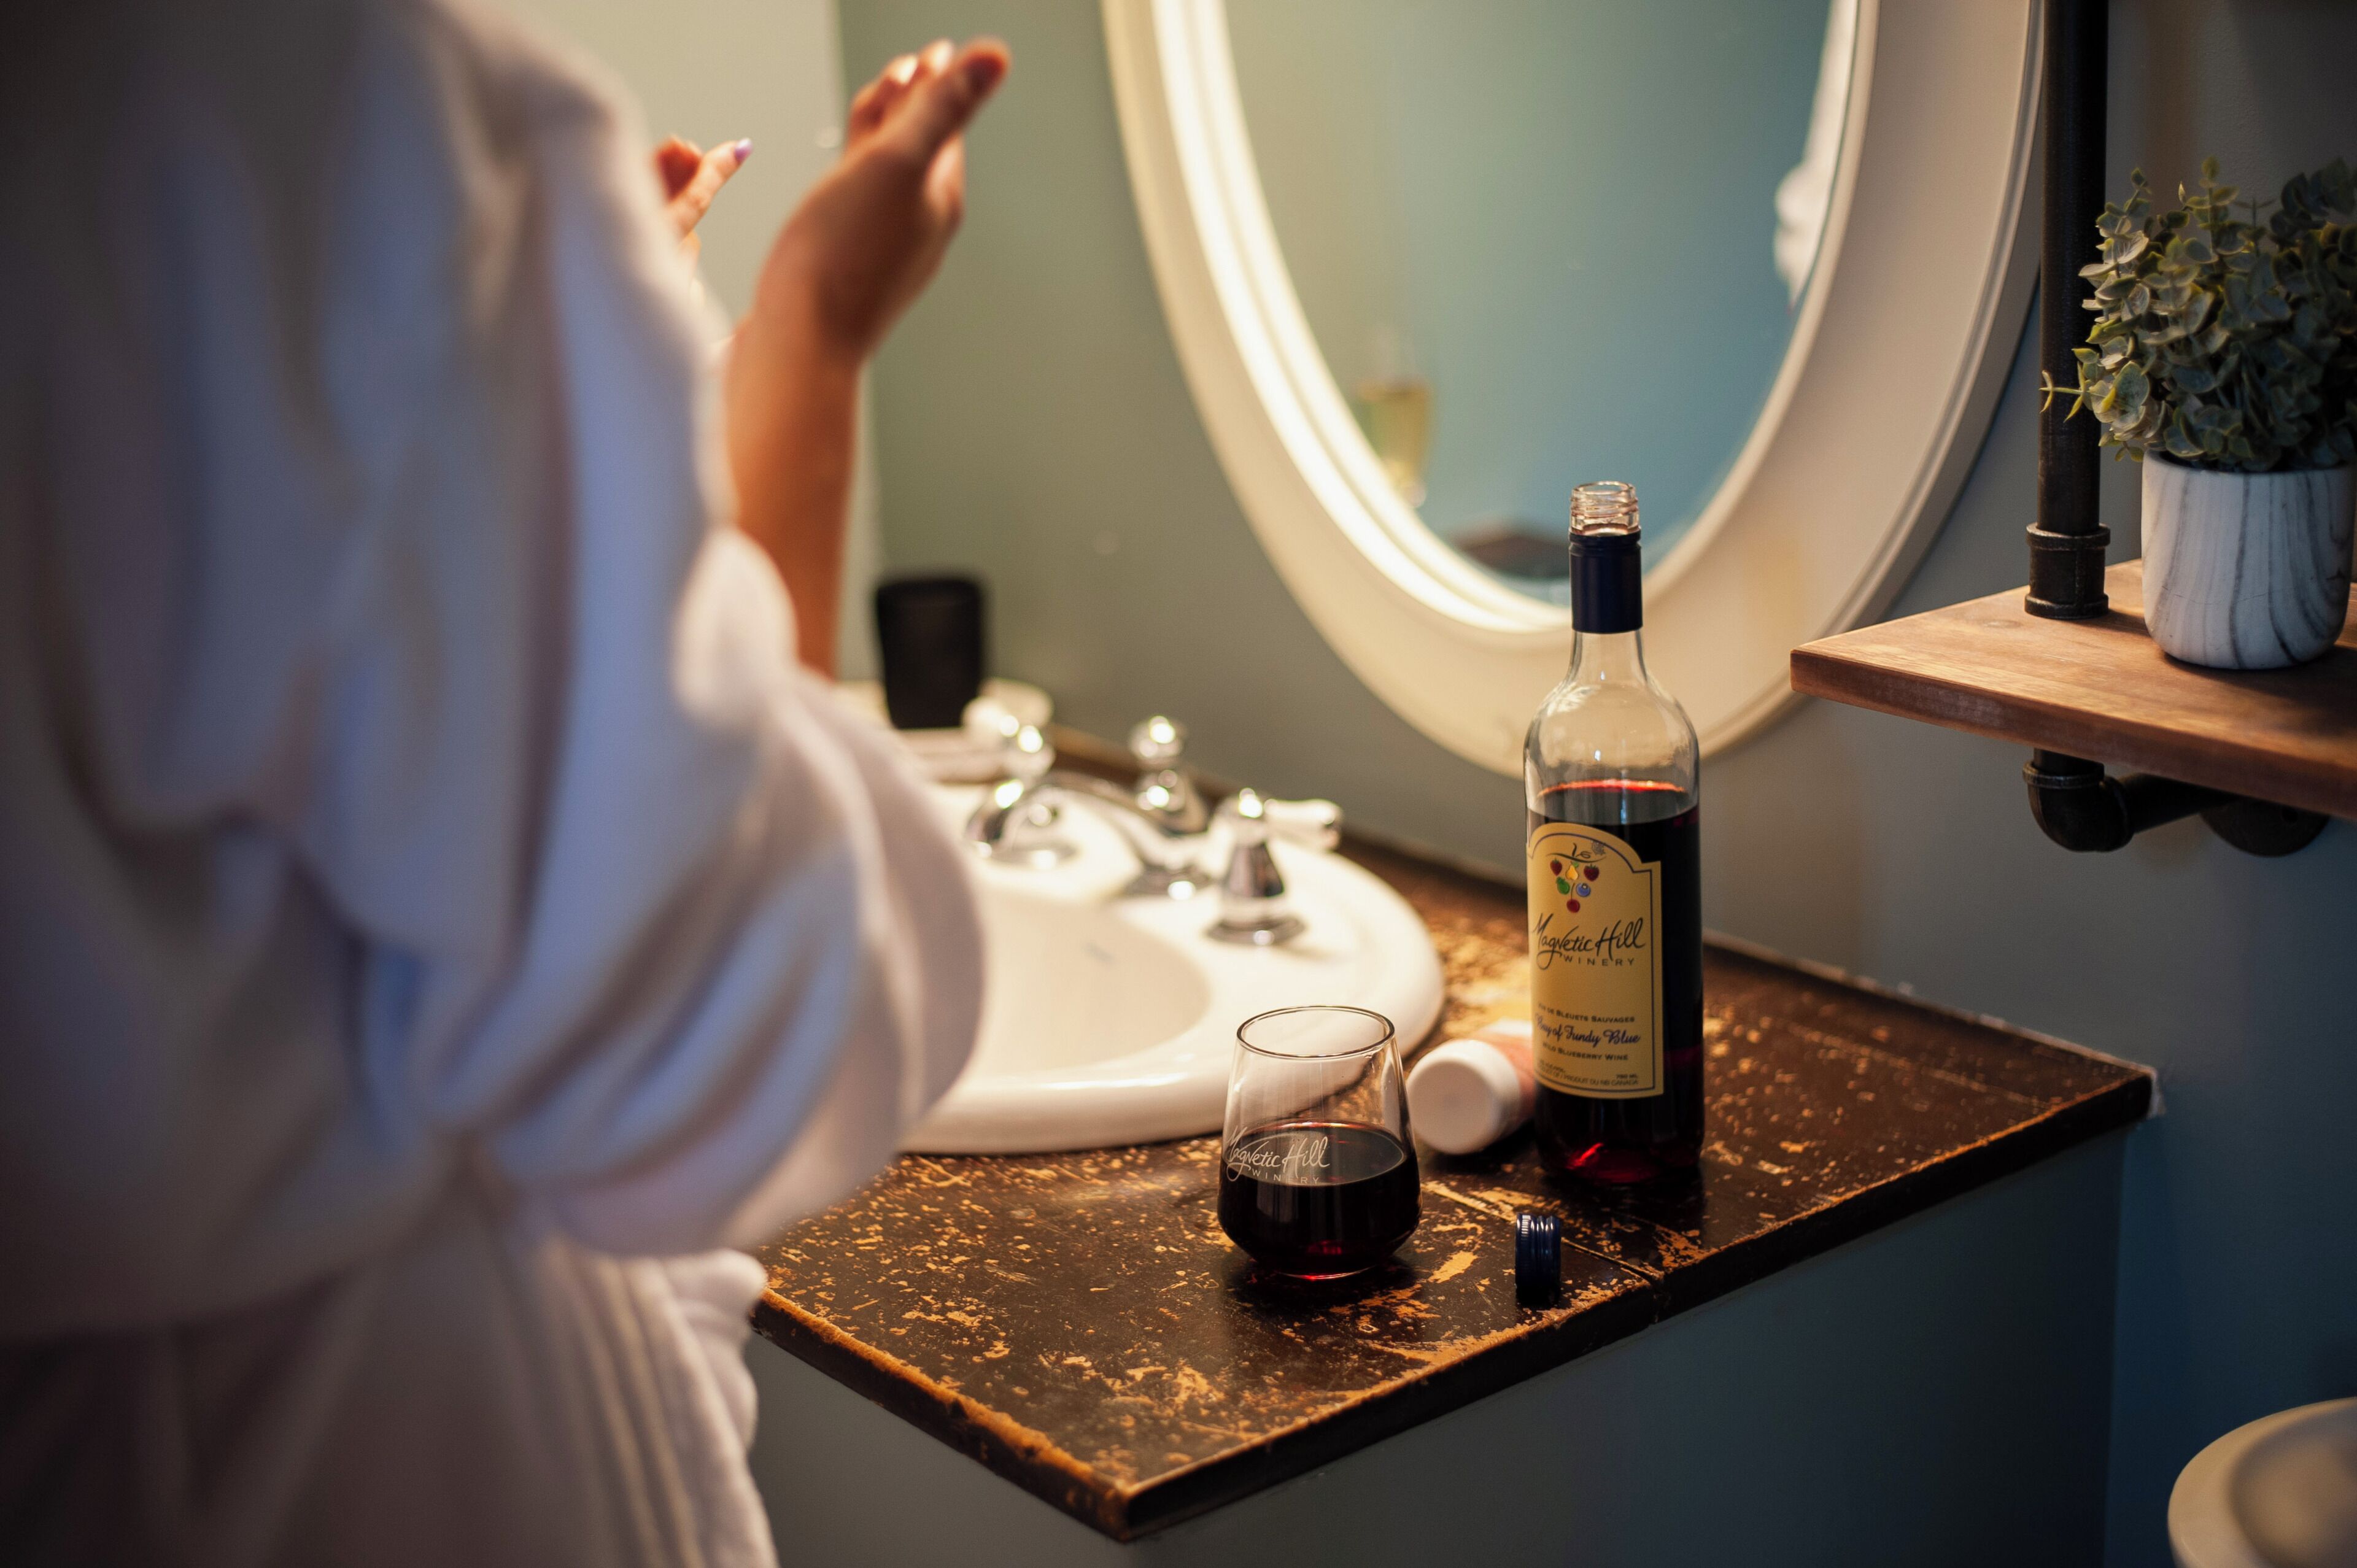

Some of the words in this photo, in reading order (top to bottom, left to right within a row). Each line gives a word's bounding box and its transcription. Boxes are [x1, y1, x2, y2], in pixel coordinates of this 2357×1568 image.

[1595, 917, 1646, 961] Hill
[1563, 954, 1635, 966] WINERY
[1552, 1024, 1563, 1041] of
[1565, 1024, 1601, 1048] Fundy
[1603, 1029, 1641, 1044] Blue
[1282, 1135, 1331, 1178] Hill
